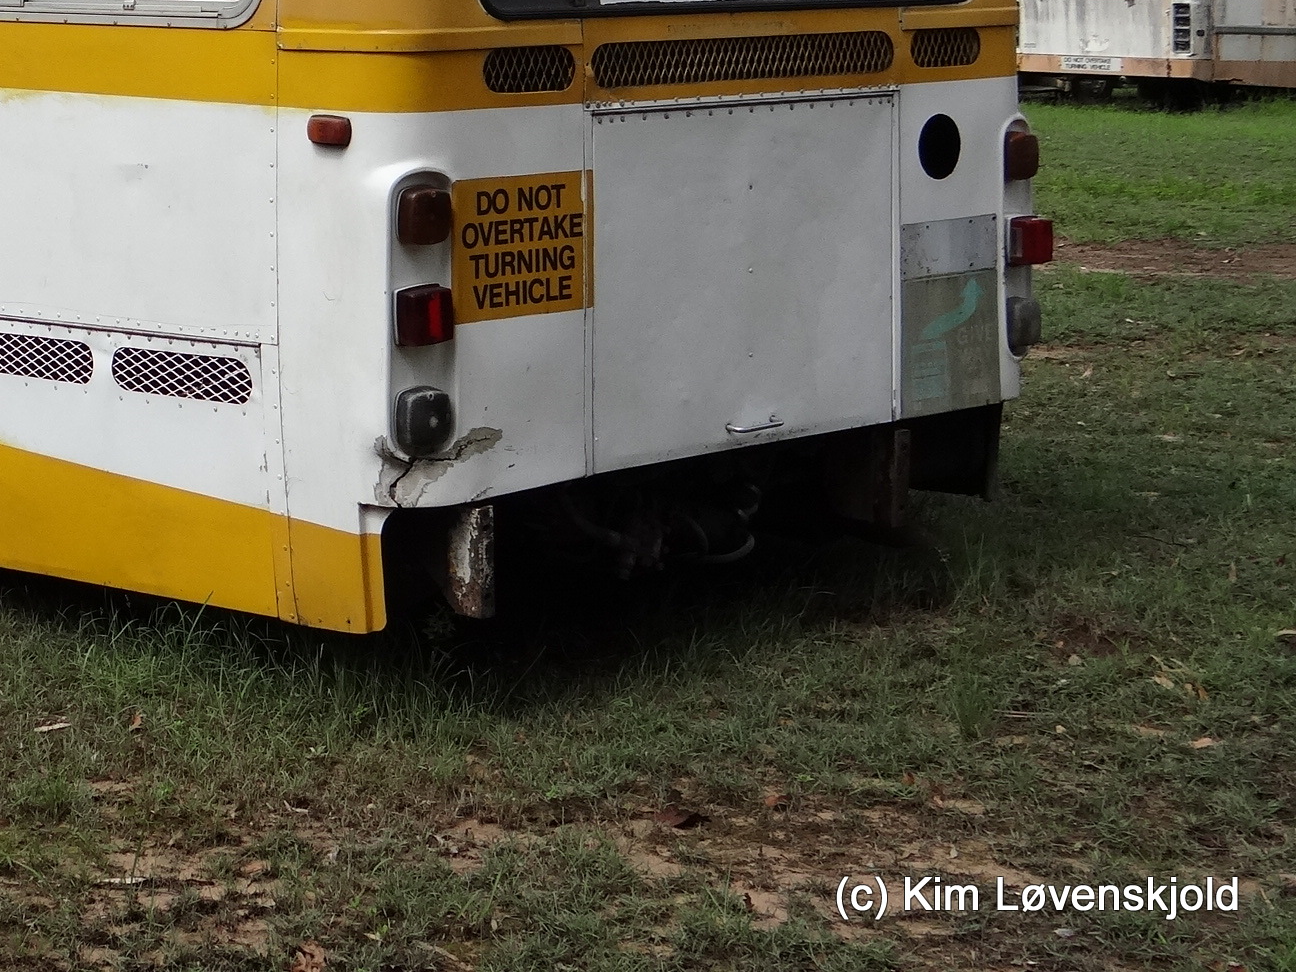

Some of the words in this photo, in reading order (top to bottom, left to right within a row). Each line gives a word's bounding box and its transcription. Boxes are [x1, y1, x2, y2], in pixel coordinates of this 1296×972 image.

[476, 188, 510, 216] DO
[517, 183, 566, 212] NOT
[461, 212, 584, 249] OVERTAKE
[469, 244, 576, 280] TURNING
[472, 274, 573, 310] VEHICLE
